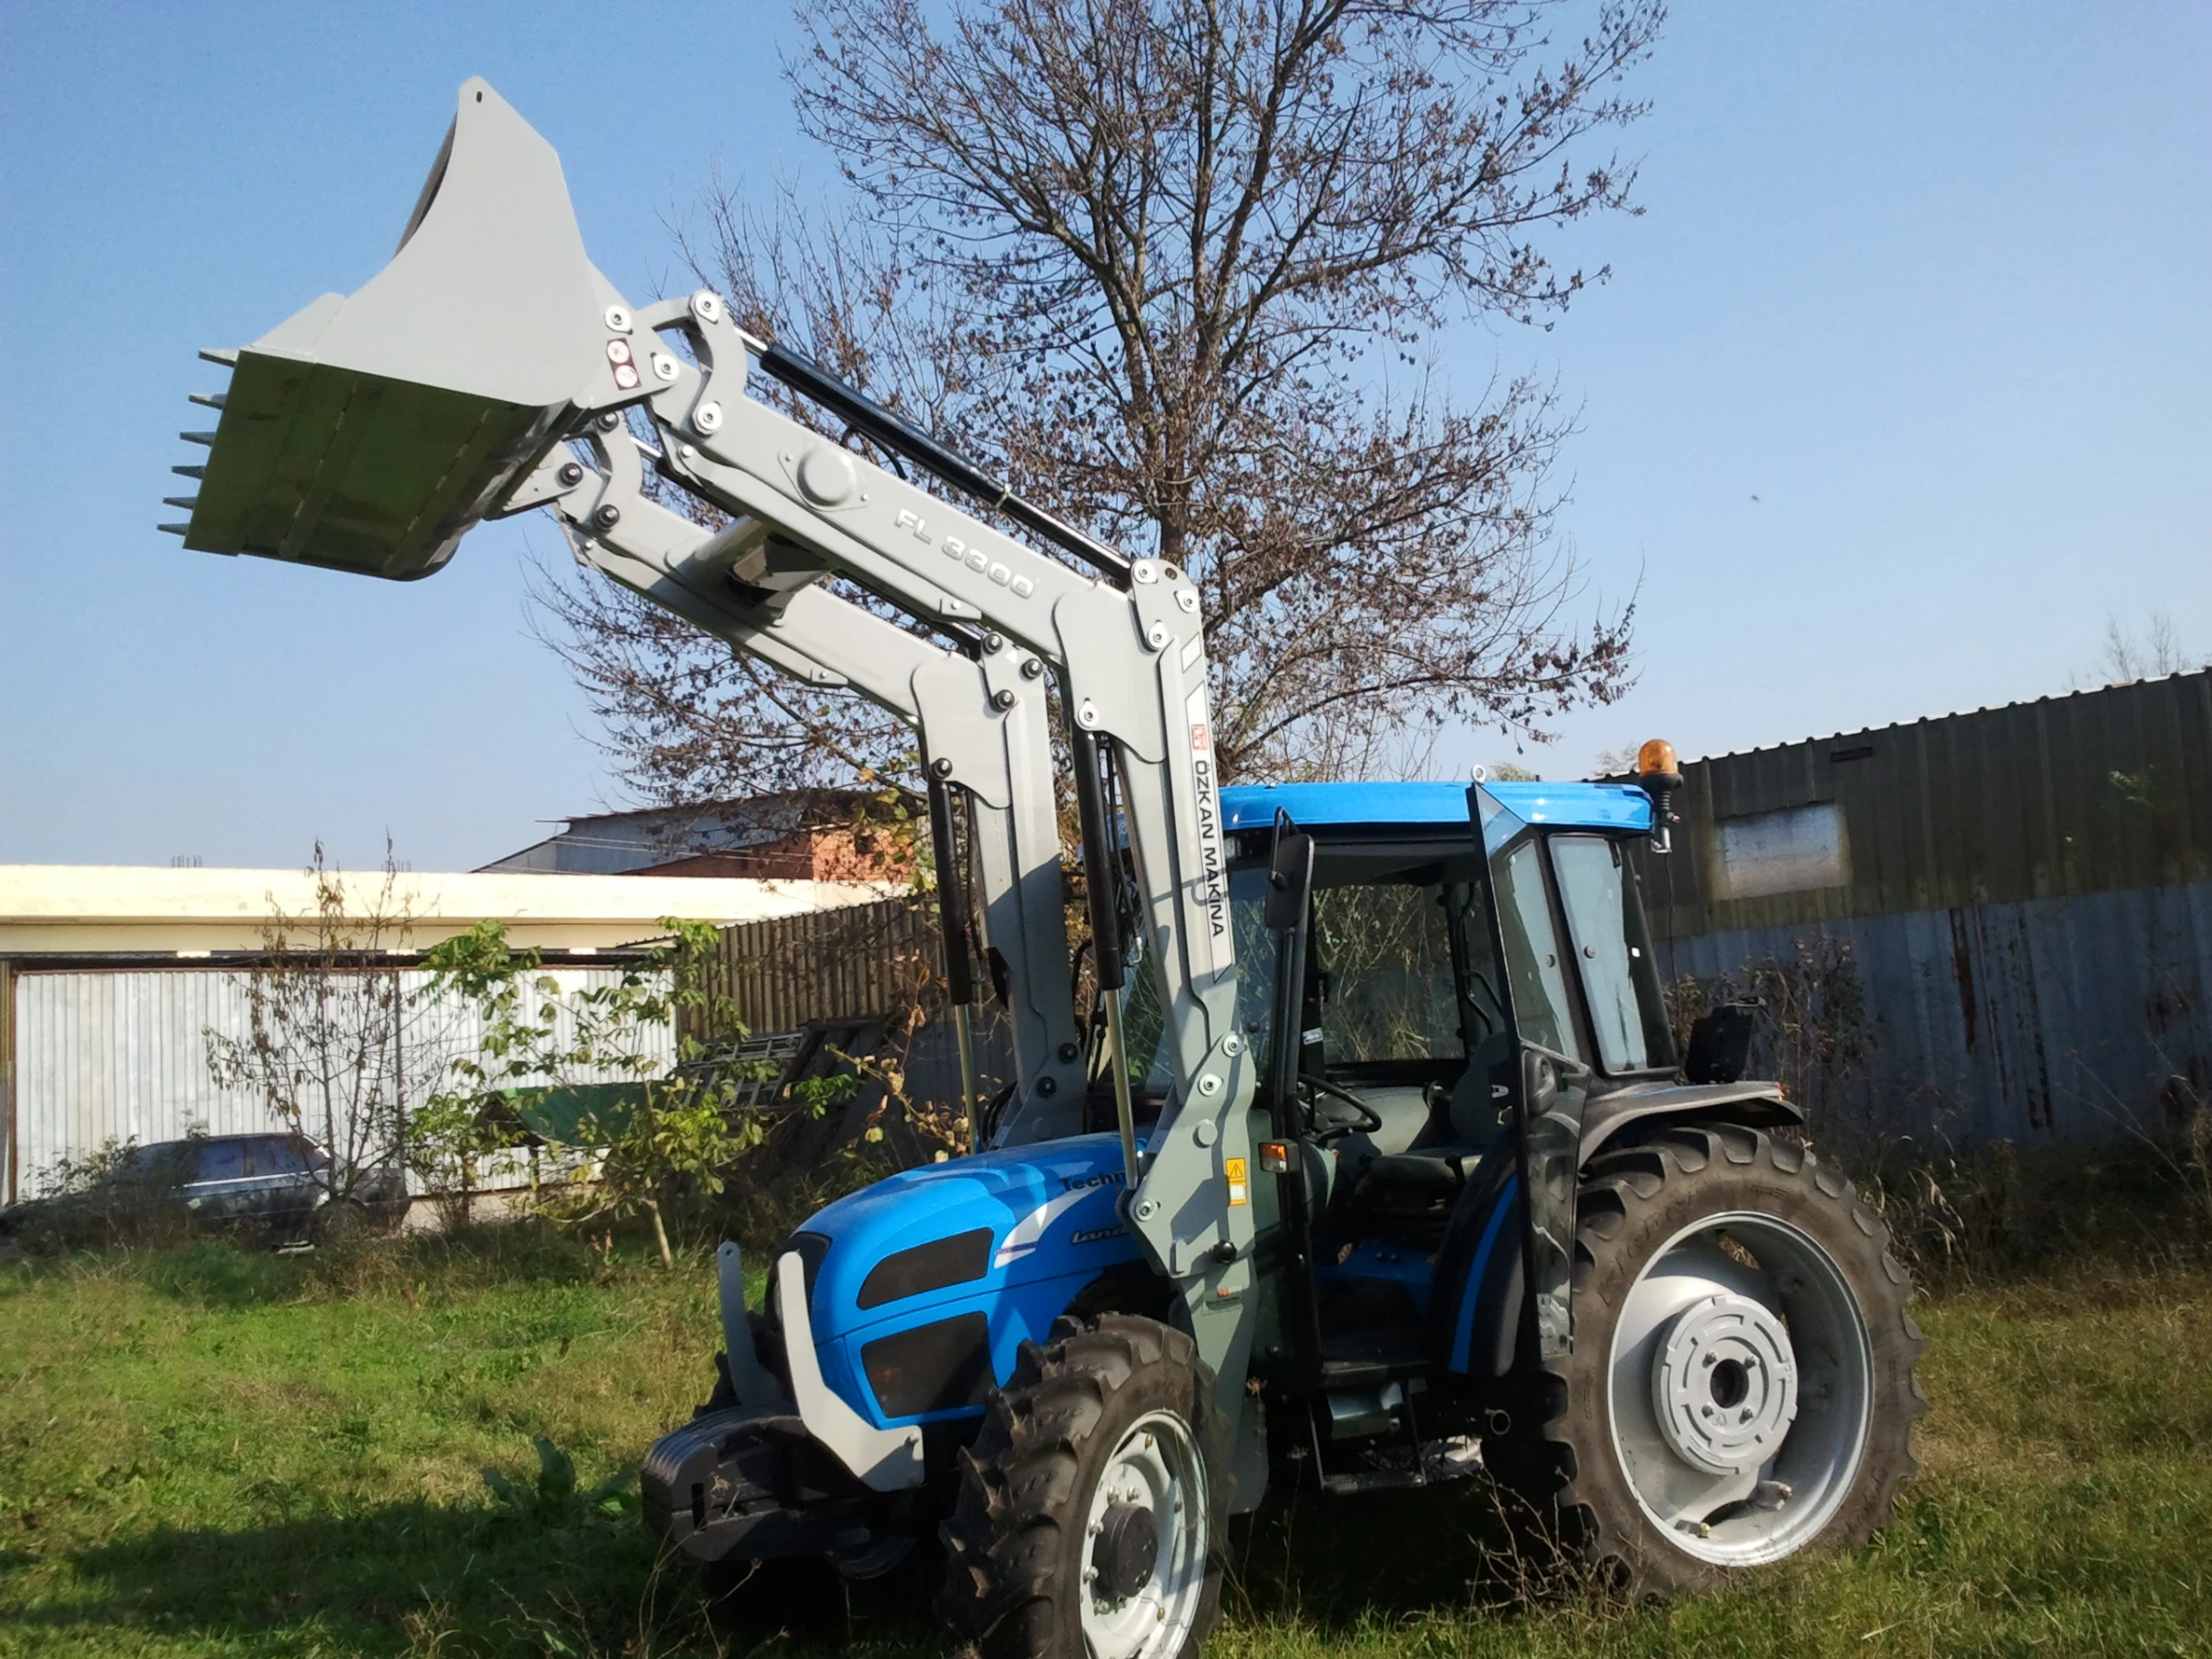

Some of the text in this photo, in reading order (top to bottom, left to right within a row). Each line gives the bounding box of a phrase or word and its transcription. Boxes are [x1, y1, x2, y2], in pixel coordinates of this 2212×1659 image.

[894, 508, 1034, 599] FL 3300
[1195, 760, 1215, 840] ÖZKAN
[1204, 847, 1225, 937] MAKİNA
[1058, 1171, 1125, 1192] Techn
